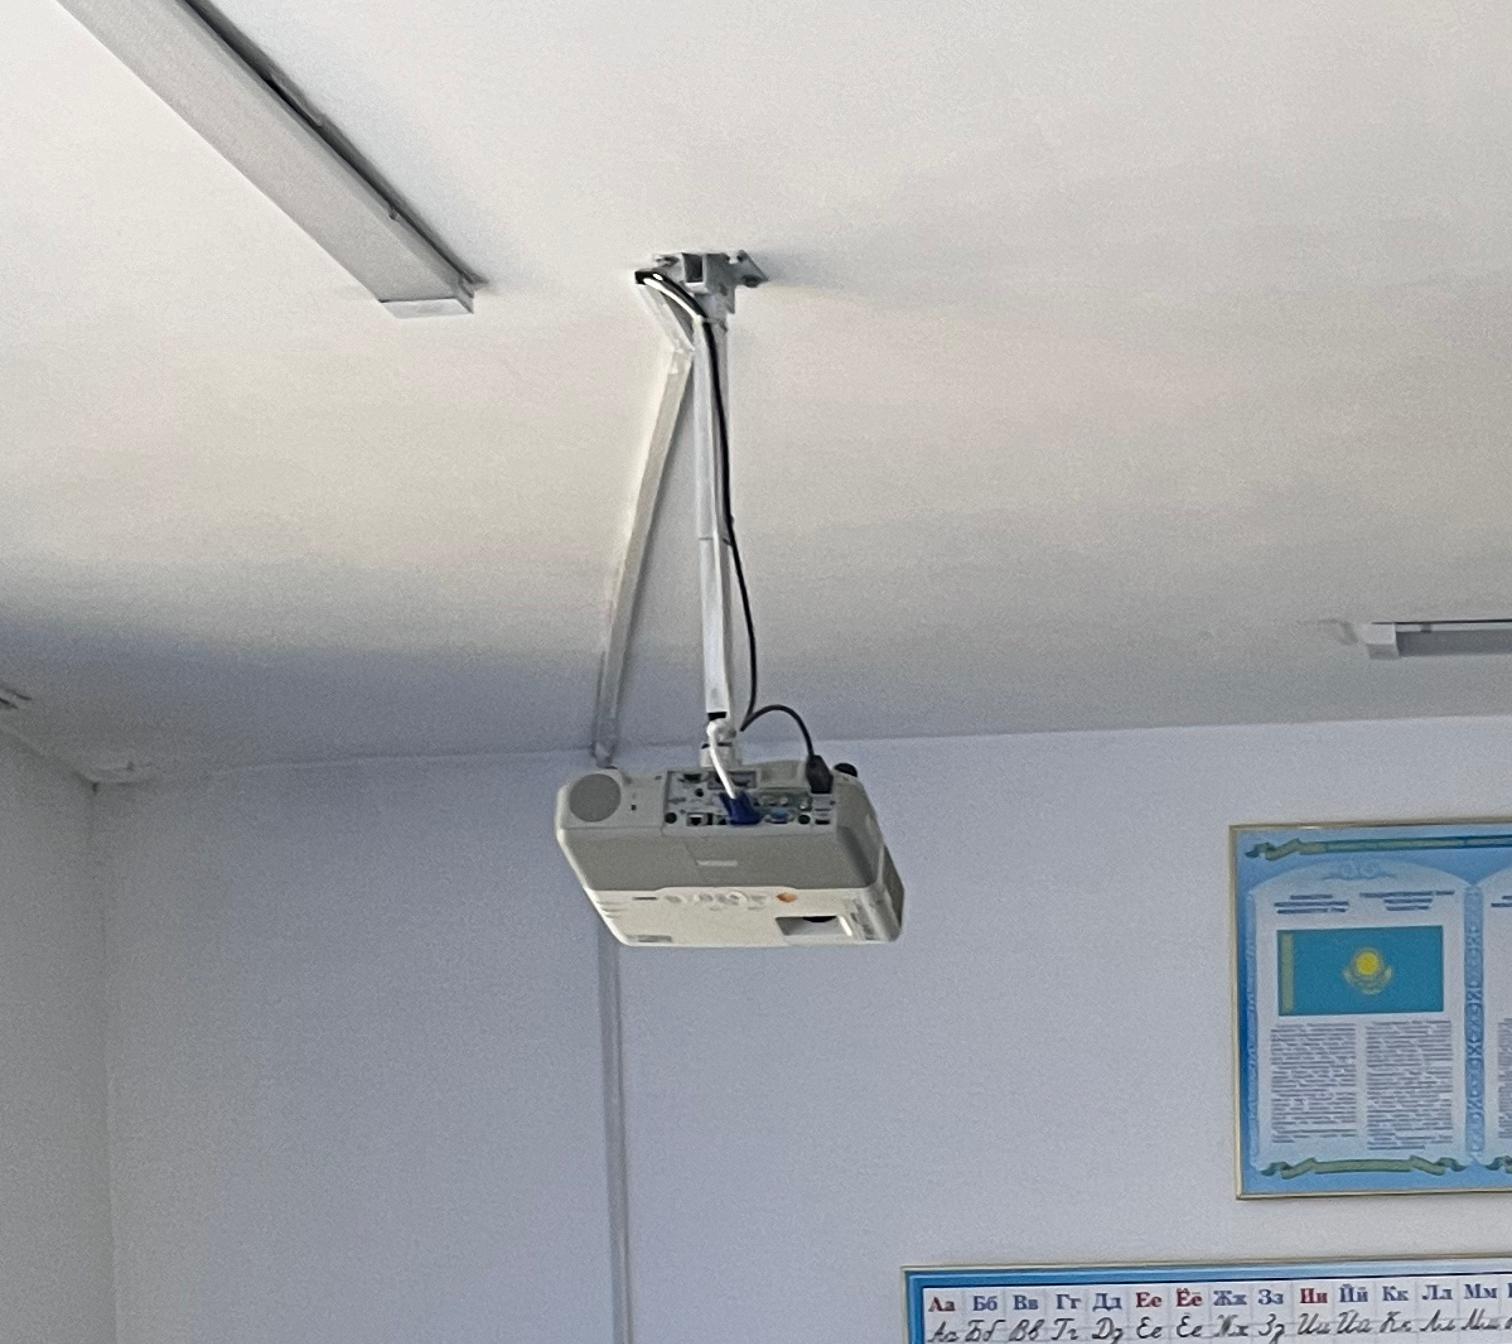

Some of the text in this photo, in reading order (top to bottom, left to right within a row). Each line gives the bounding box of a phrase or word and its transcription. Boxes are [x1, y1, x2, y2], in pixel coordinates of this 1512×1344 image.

[973, 1295, 997, 1312] Бб
[1014, 1295, 1038, 1310] Вв
[1056, 1294, 1081, 1309] Гг
[1093, 1294, 1122, 1310] Дд
[1136, 1292, 1162, 1307] Ее
[1258, 1289, 1283, 1305] Зз
